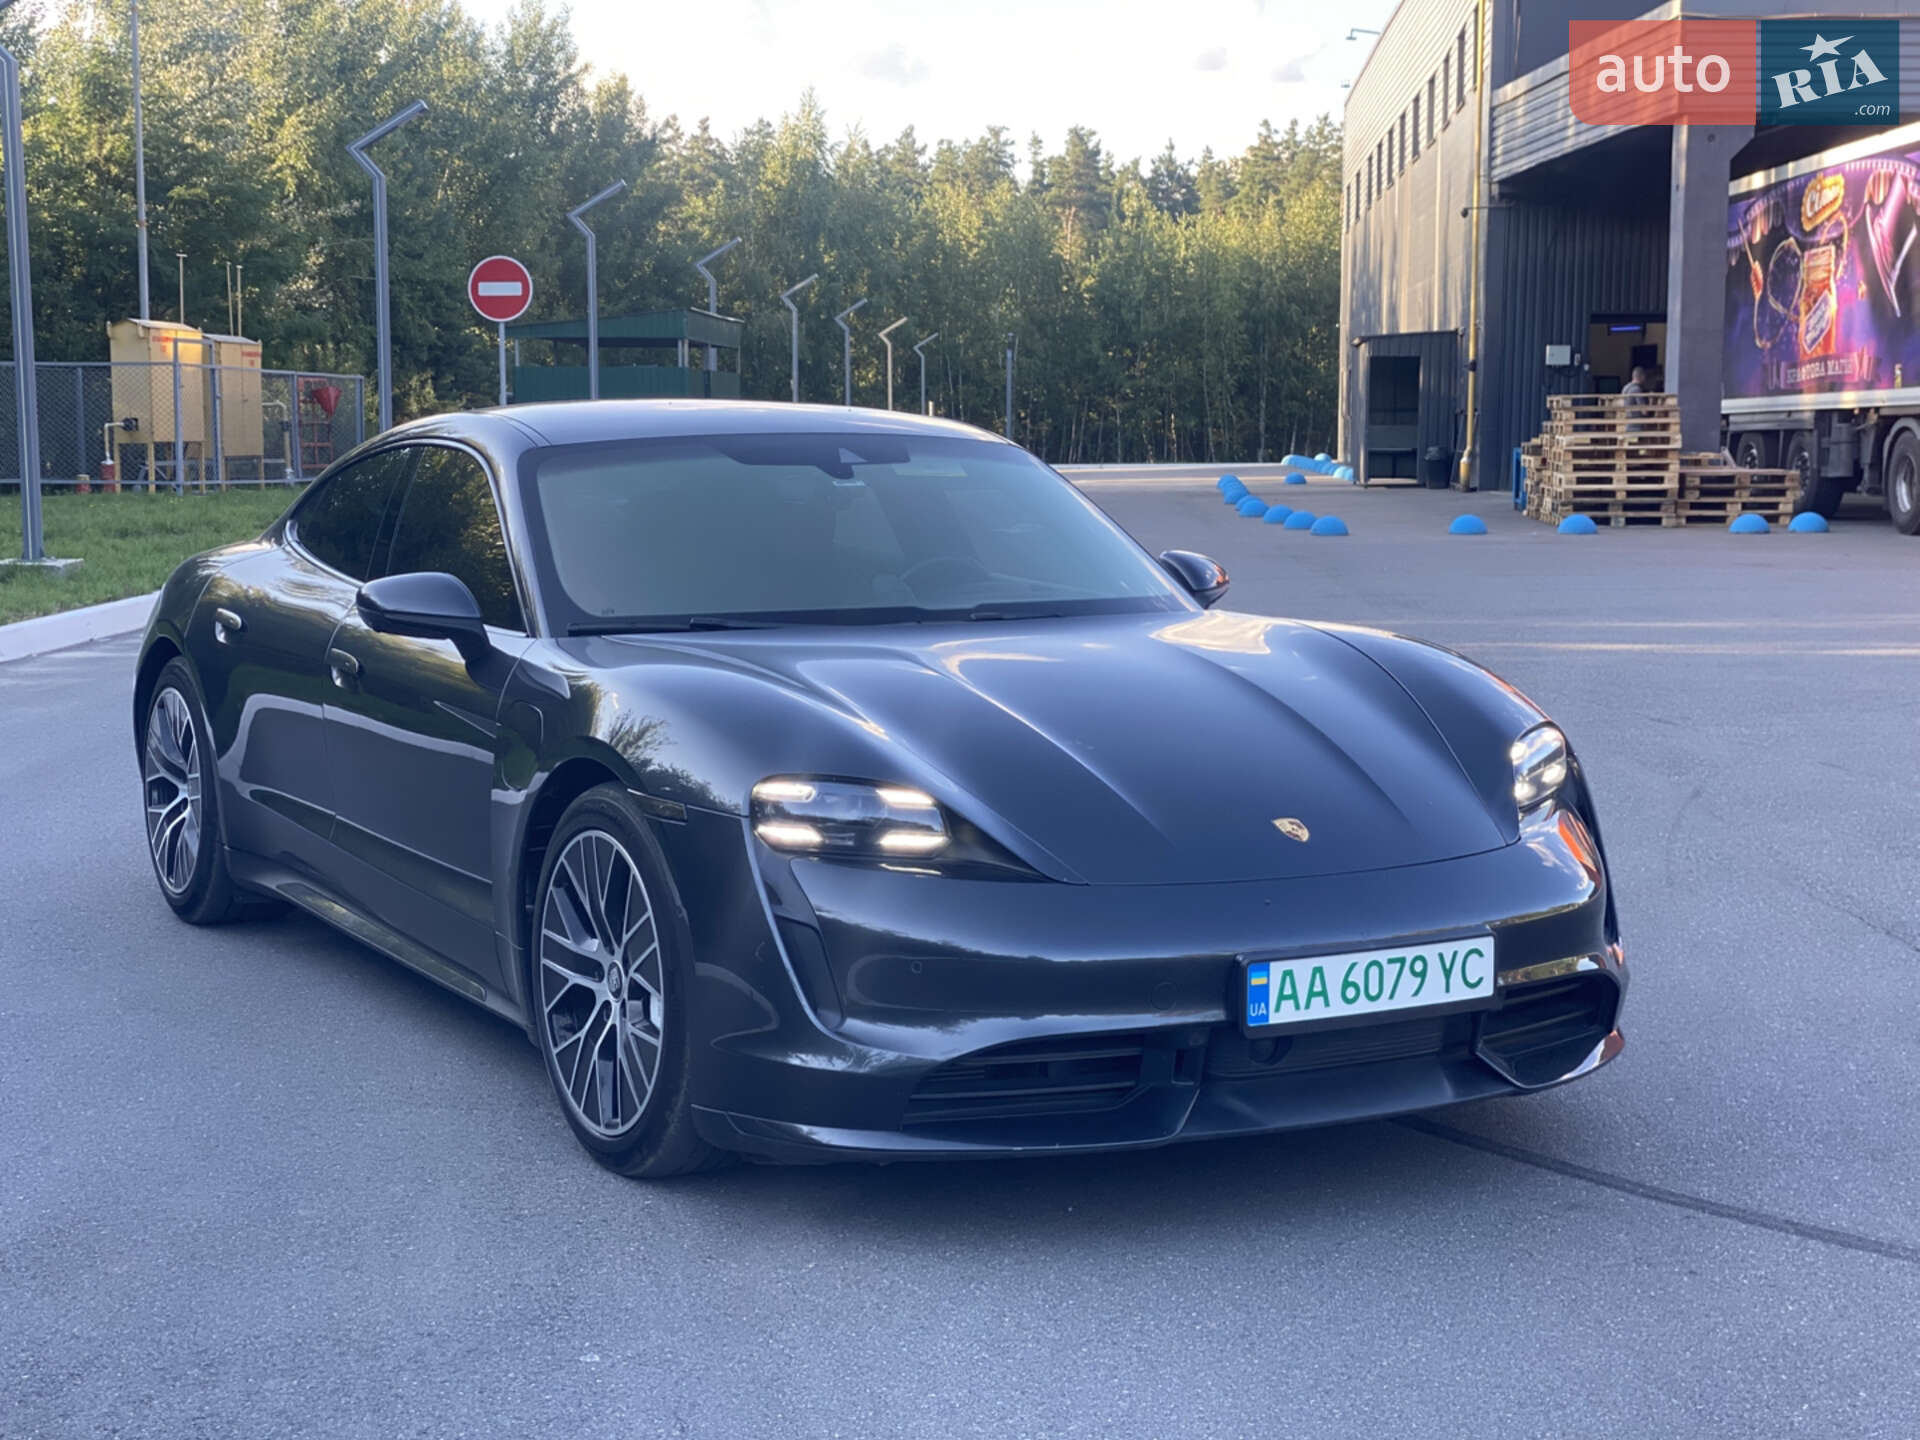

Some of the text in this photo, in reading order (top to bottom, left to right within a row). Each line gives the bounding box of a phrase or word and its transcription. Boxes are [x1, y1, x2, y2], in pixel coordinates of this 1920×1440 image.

[1274, 948, 1485, 1013] AA 6079 YC
[1250, 1002, 1267, 1017] UA
